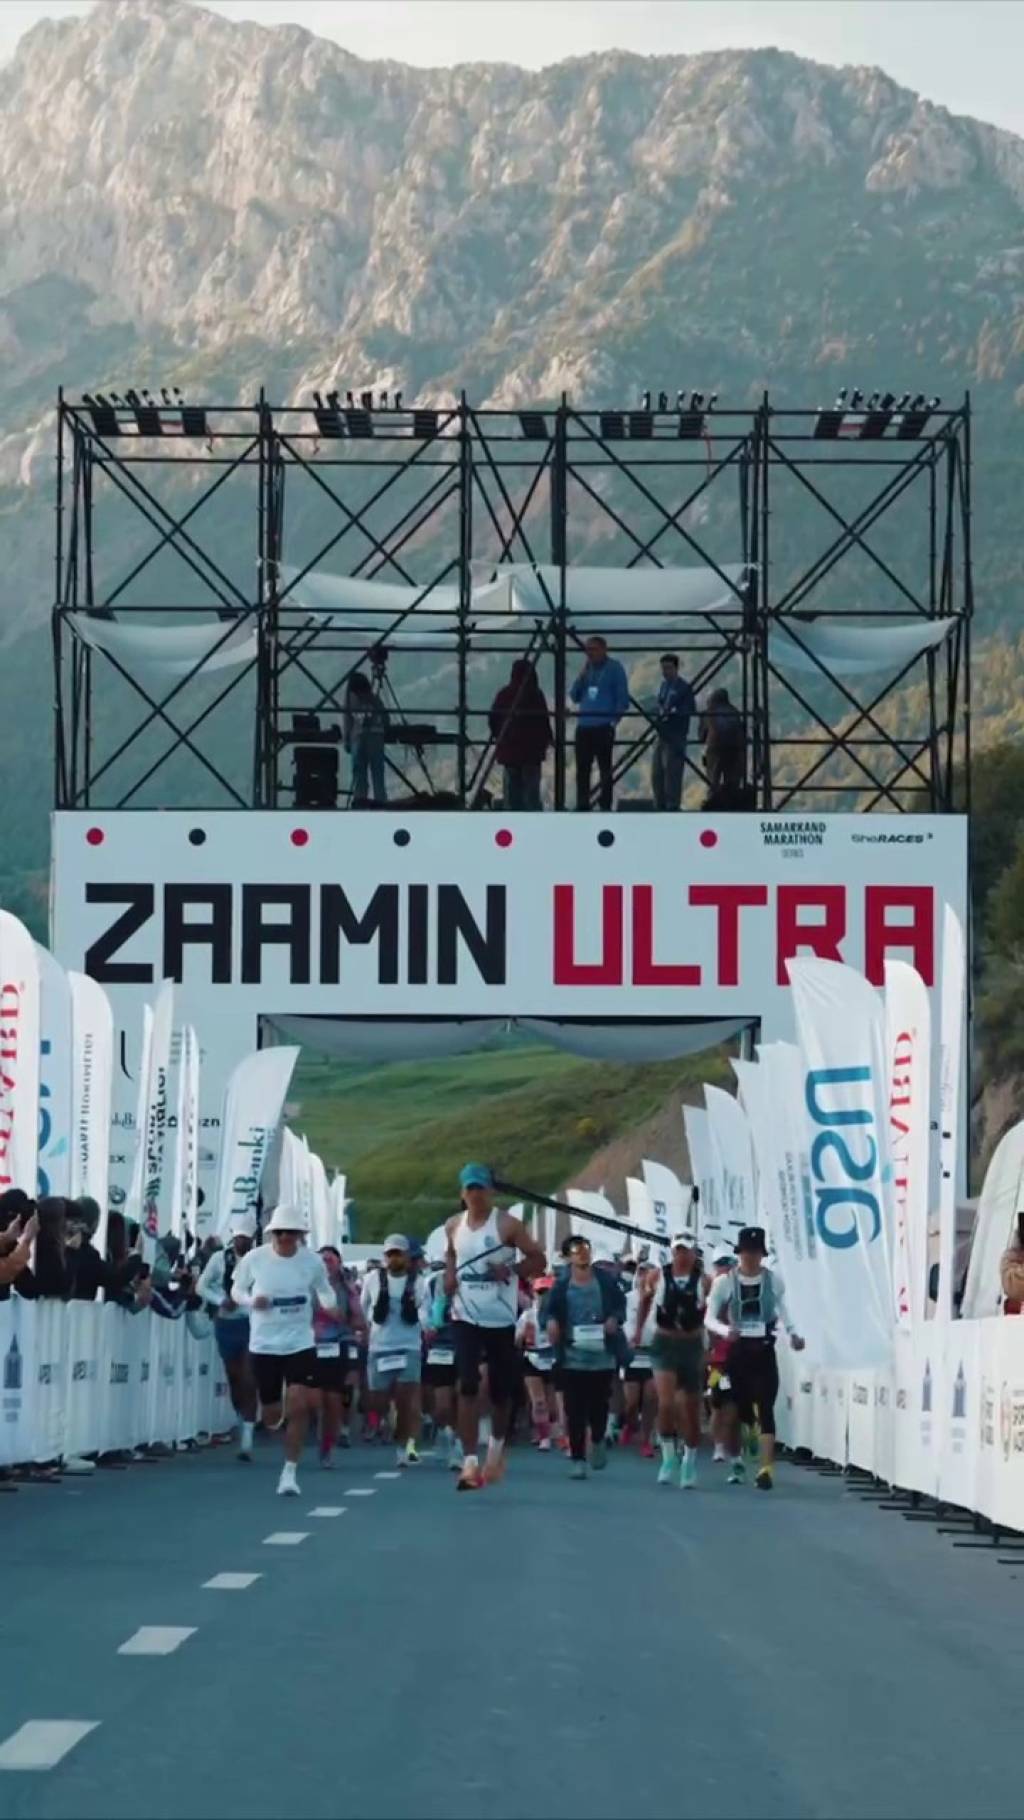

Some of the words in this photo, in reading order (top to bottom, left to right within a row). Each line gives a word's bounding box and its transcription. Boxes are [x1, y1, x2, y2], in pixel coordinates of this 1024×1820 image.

[760, 821, 827, 833] SAMARKAND
[763, 833, 823, 845] MARATHON
[85, 883, 507, 985] ZAAMIN
[553, 885, 934, 987] ULTRA
